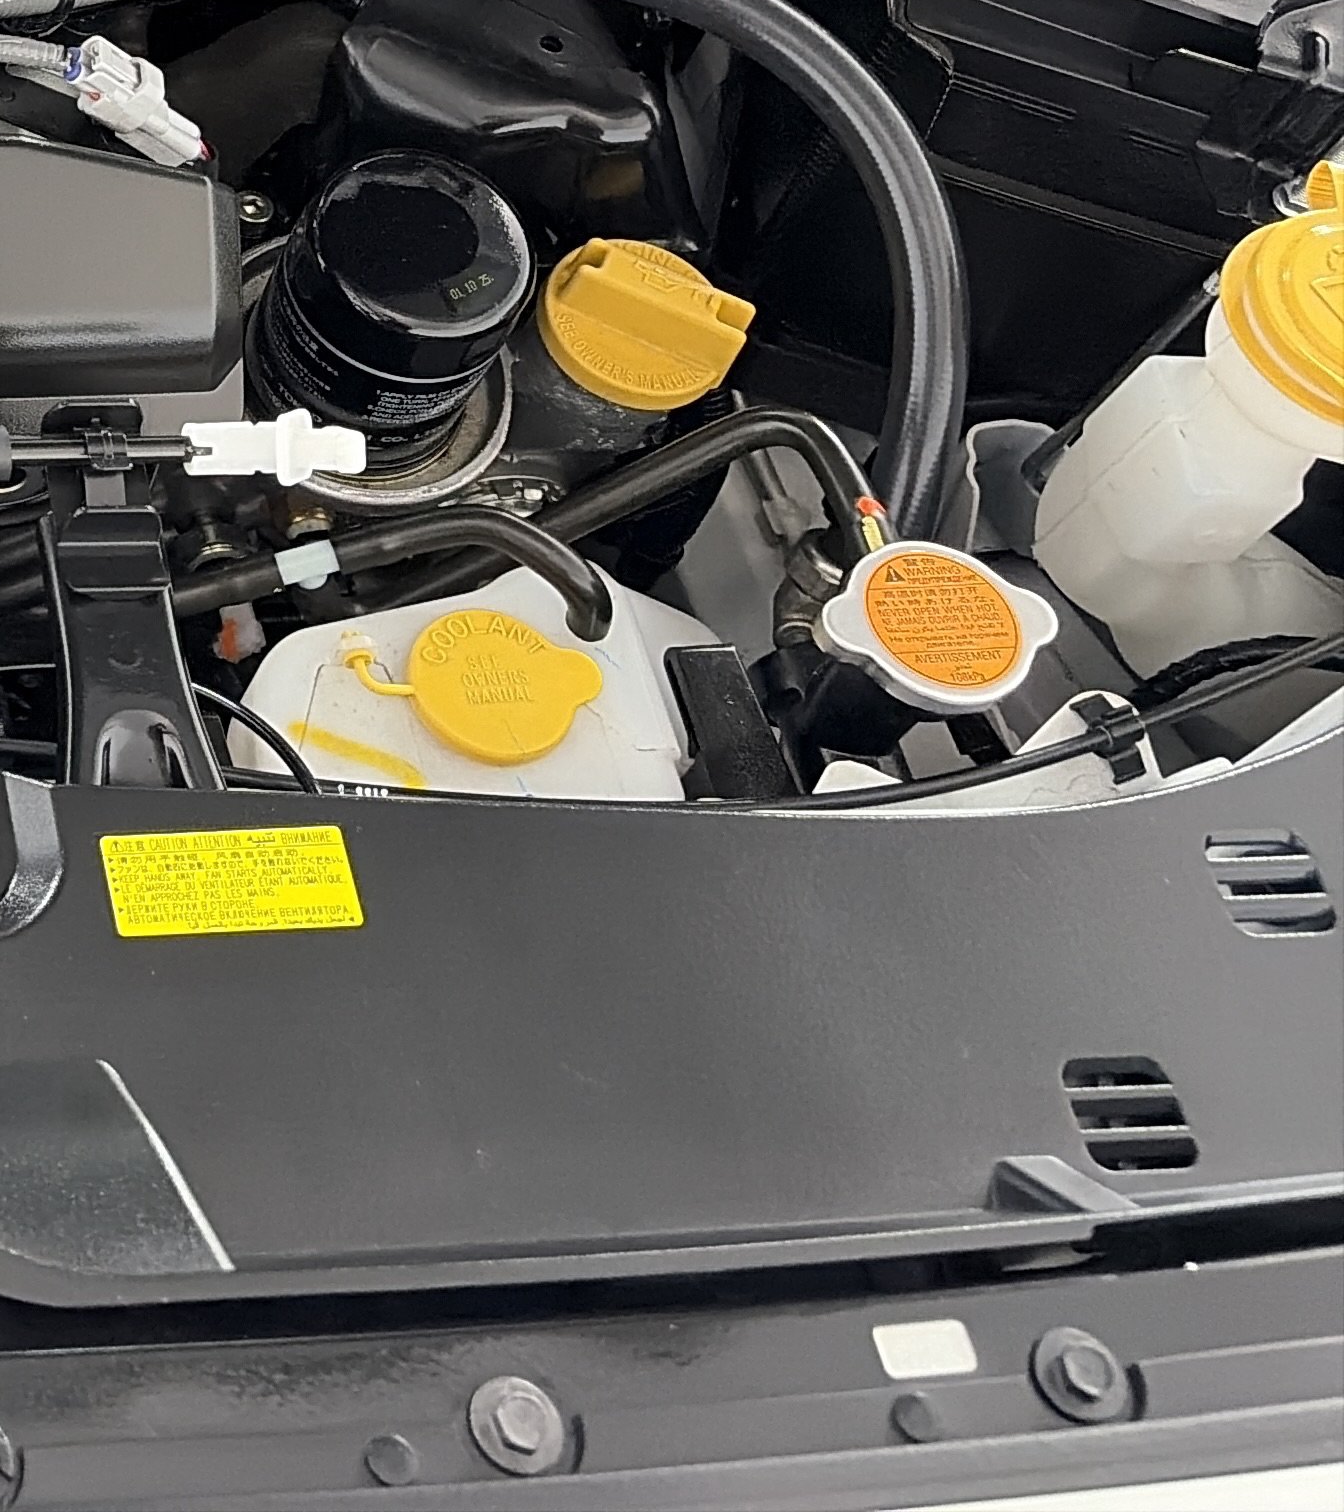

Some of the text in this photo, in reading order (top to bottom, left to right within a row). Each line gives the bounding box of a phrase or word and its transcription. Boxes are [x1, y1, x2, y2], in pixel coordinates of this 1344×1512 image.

[556, 313, 702, 390] SEE OWNER'S MANUAL
[903, 565, 961, 577] WARNING
[877, 607, 911, 617] NEVER
[914, 606, 941, 615] OPEN
[942, 604, 974, 615] WHEN
[896, 614, 927, 626] JAMAIS
[928, 614, 961, 625] OUVRIR
[421, 614, 546, 665] COOLANT
[467, 655, 502, 671] SEE
[914, 650, 1003, 664] AVERTISSEMENT
[461, 670, 530, 688] OWNERS
[465, 685, 535, 705] MANUAL
[149, 837, 188, 851] CAUTION
[193, 834, 242, 849] ATTENTION
[280, 831, 333, 845] ВНИМАНИЕ
[119, 874, 140, 883] KEEP
[144, 873, 171, 882] HANDS
[205, 870, 222, 879] FAN
[226, 869, 258, 879] STARTS
[121, 885, 131, 894] LE
[185, 881, 196, 890] DU
[200, 878, 254, 890] VENTILATEUR
[151, 891, 200, 902] APPROCHEZ
[204, 890, 222, 899] PAS
[226, 888, 243, 899] LES
[173, 902, 198, 912] РУКИ
[128, 911, 217, 925] АВТОМАТИЧЕСКОЕ
[219, 907, 277, 921] ВКЛЮЧЕНИЕ
